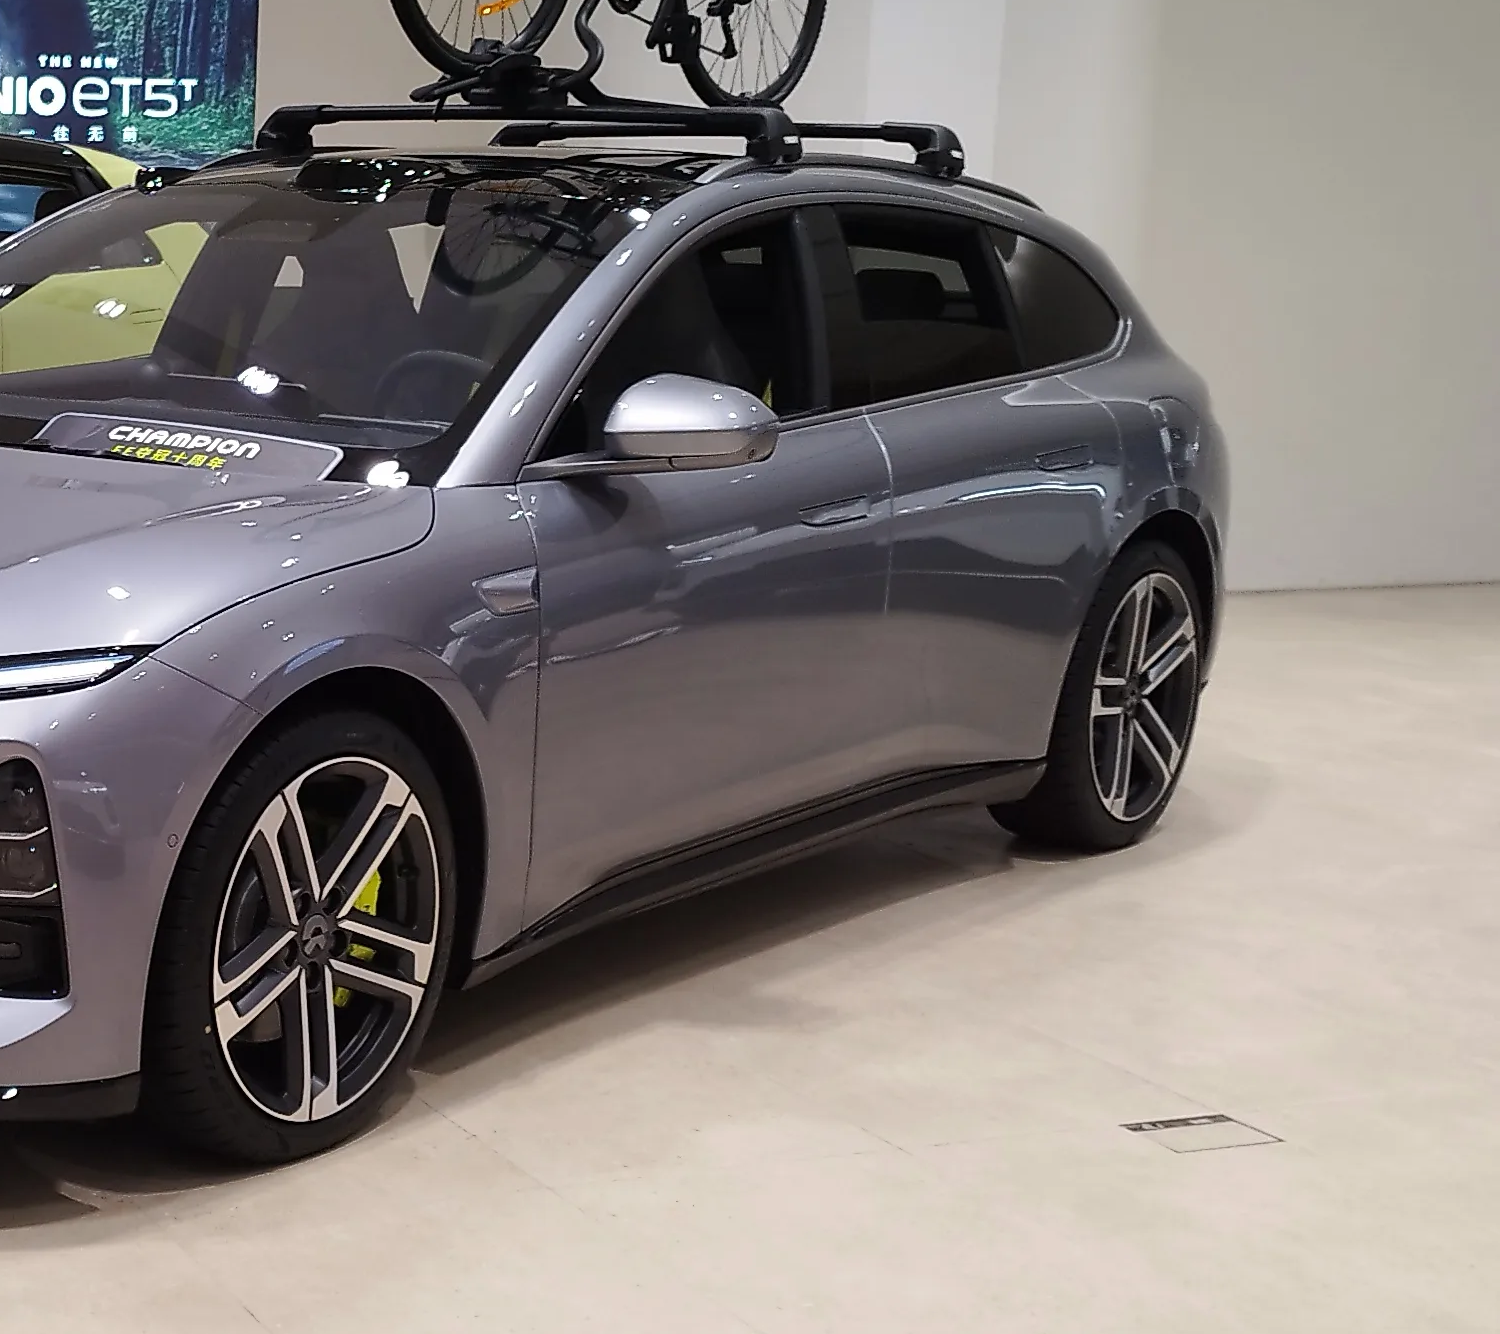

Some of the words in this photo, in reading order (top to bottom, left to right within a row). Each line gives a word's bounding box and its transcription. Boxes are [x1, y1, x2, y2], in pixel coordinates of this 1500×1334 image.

[38, 54, 72, 68] THE
[80, 55, 119, 69] NEW
[108, 425, 261, 459] CHAMPION
